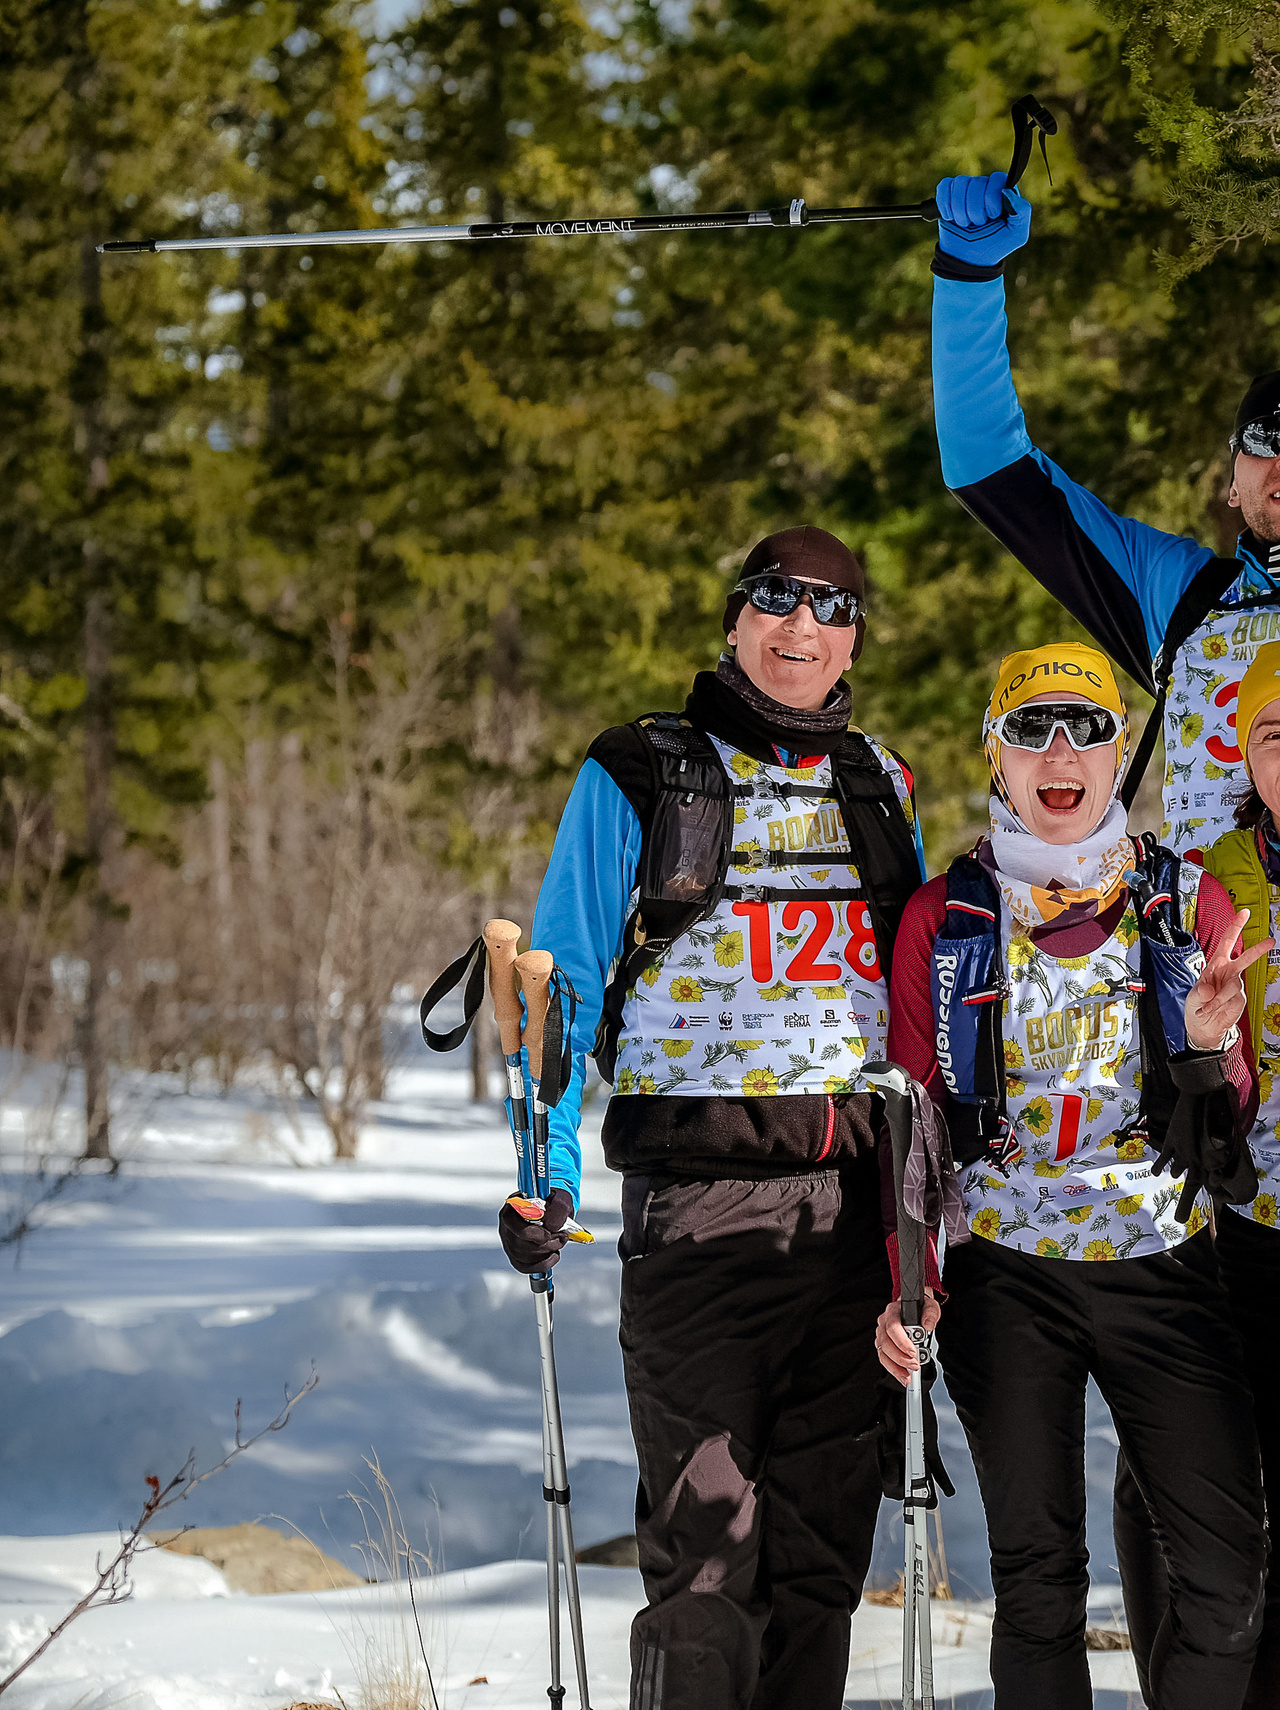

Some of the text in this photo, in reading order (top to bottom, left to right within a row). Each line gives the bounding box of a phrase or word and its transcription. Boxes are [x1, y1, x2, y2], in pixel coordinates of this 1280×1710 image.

[998, 661, 1103, 712] ПОЛЮС
[731, 899, 883, 983] 128
[783, 1014, 810, 1022] SPORT
[784, 1020, 811, 1028] FERMA
[1026, 1001, 1118, 1055] BORUS
